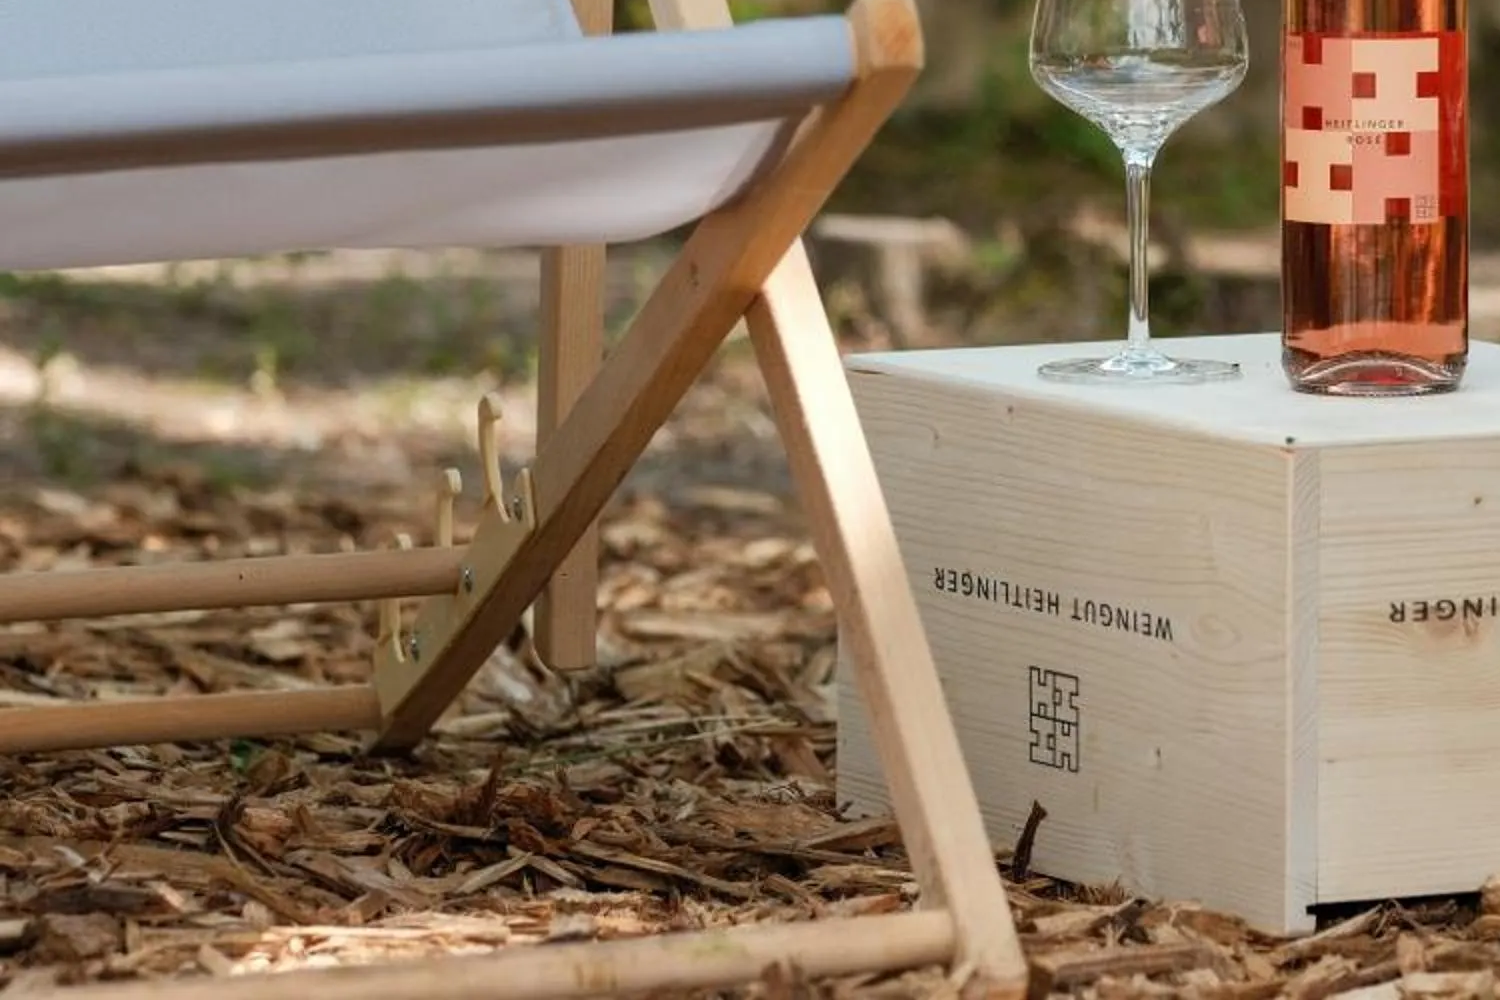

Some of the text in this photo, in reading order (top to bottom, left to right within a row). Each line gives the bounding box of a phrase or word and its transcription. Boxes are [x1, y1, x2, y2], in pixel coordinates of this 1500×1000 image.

[1325, 119, 1404, 129] HEITLINGER
[934, 567, 1174, 641] WEINGUT HEITLINGER
